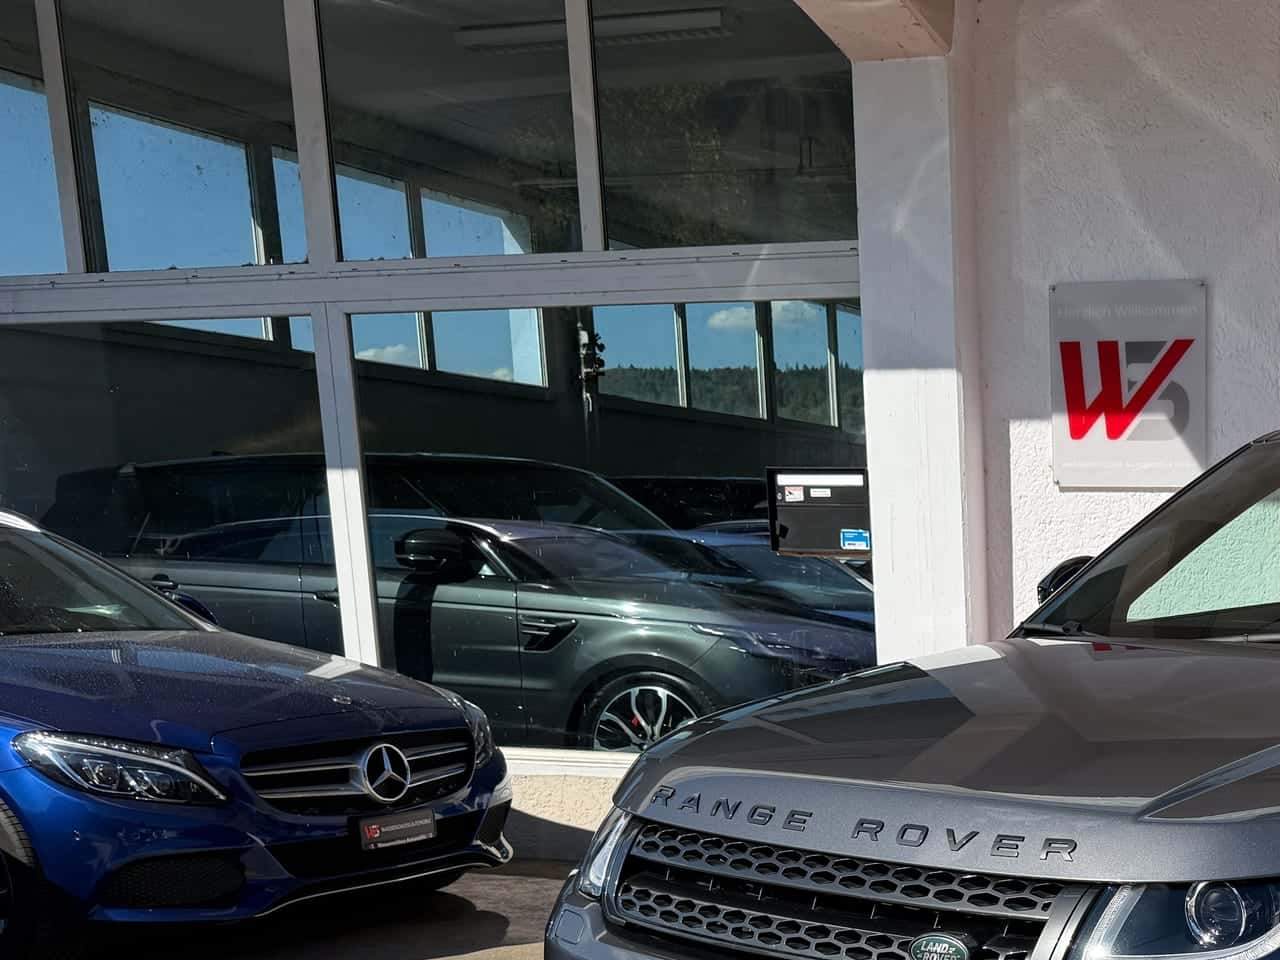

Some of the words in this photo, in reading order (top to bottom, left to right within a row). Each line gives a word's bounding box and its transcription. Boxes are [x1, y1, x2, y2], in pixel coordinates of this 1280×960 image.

[650, 784, 813, 833] RANGE
[851, 817, 1078, 862] ROVER
[920, 940, 949, 954] LAND
